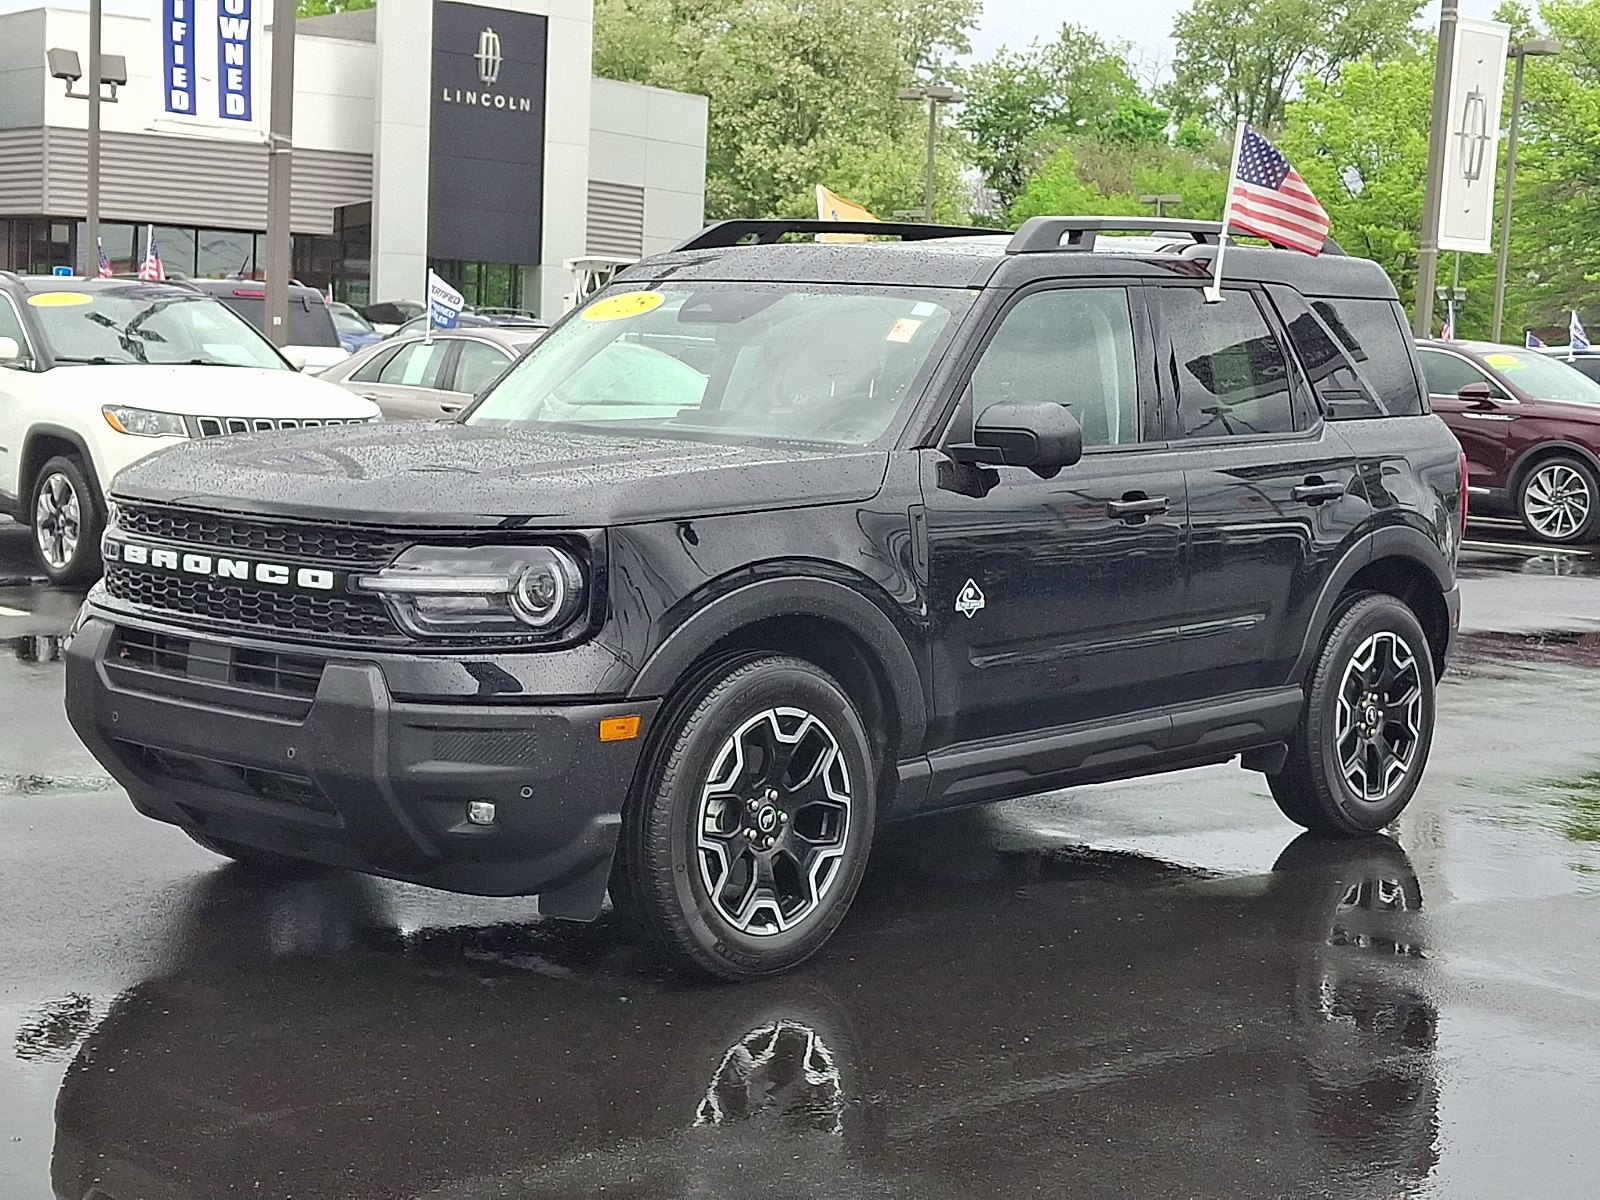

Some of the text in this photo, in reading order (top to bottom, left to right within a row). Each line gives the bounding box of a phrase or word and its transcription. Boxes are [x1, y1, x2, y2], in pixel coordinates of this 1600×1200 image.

[443, 87, 531, 112] LINCOLN
[431, 284, 461, 305] ERTIFIED
[123, 544, 334, 590] BRONCO
